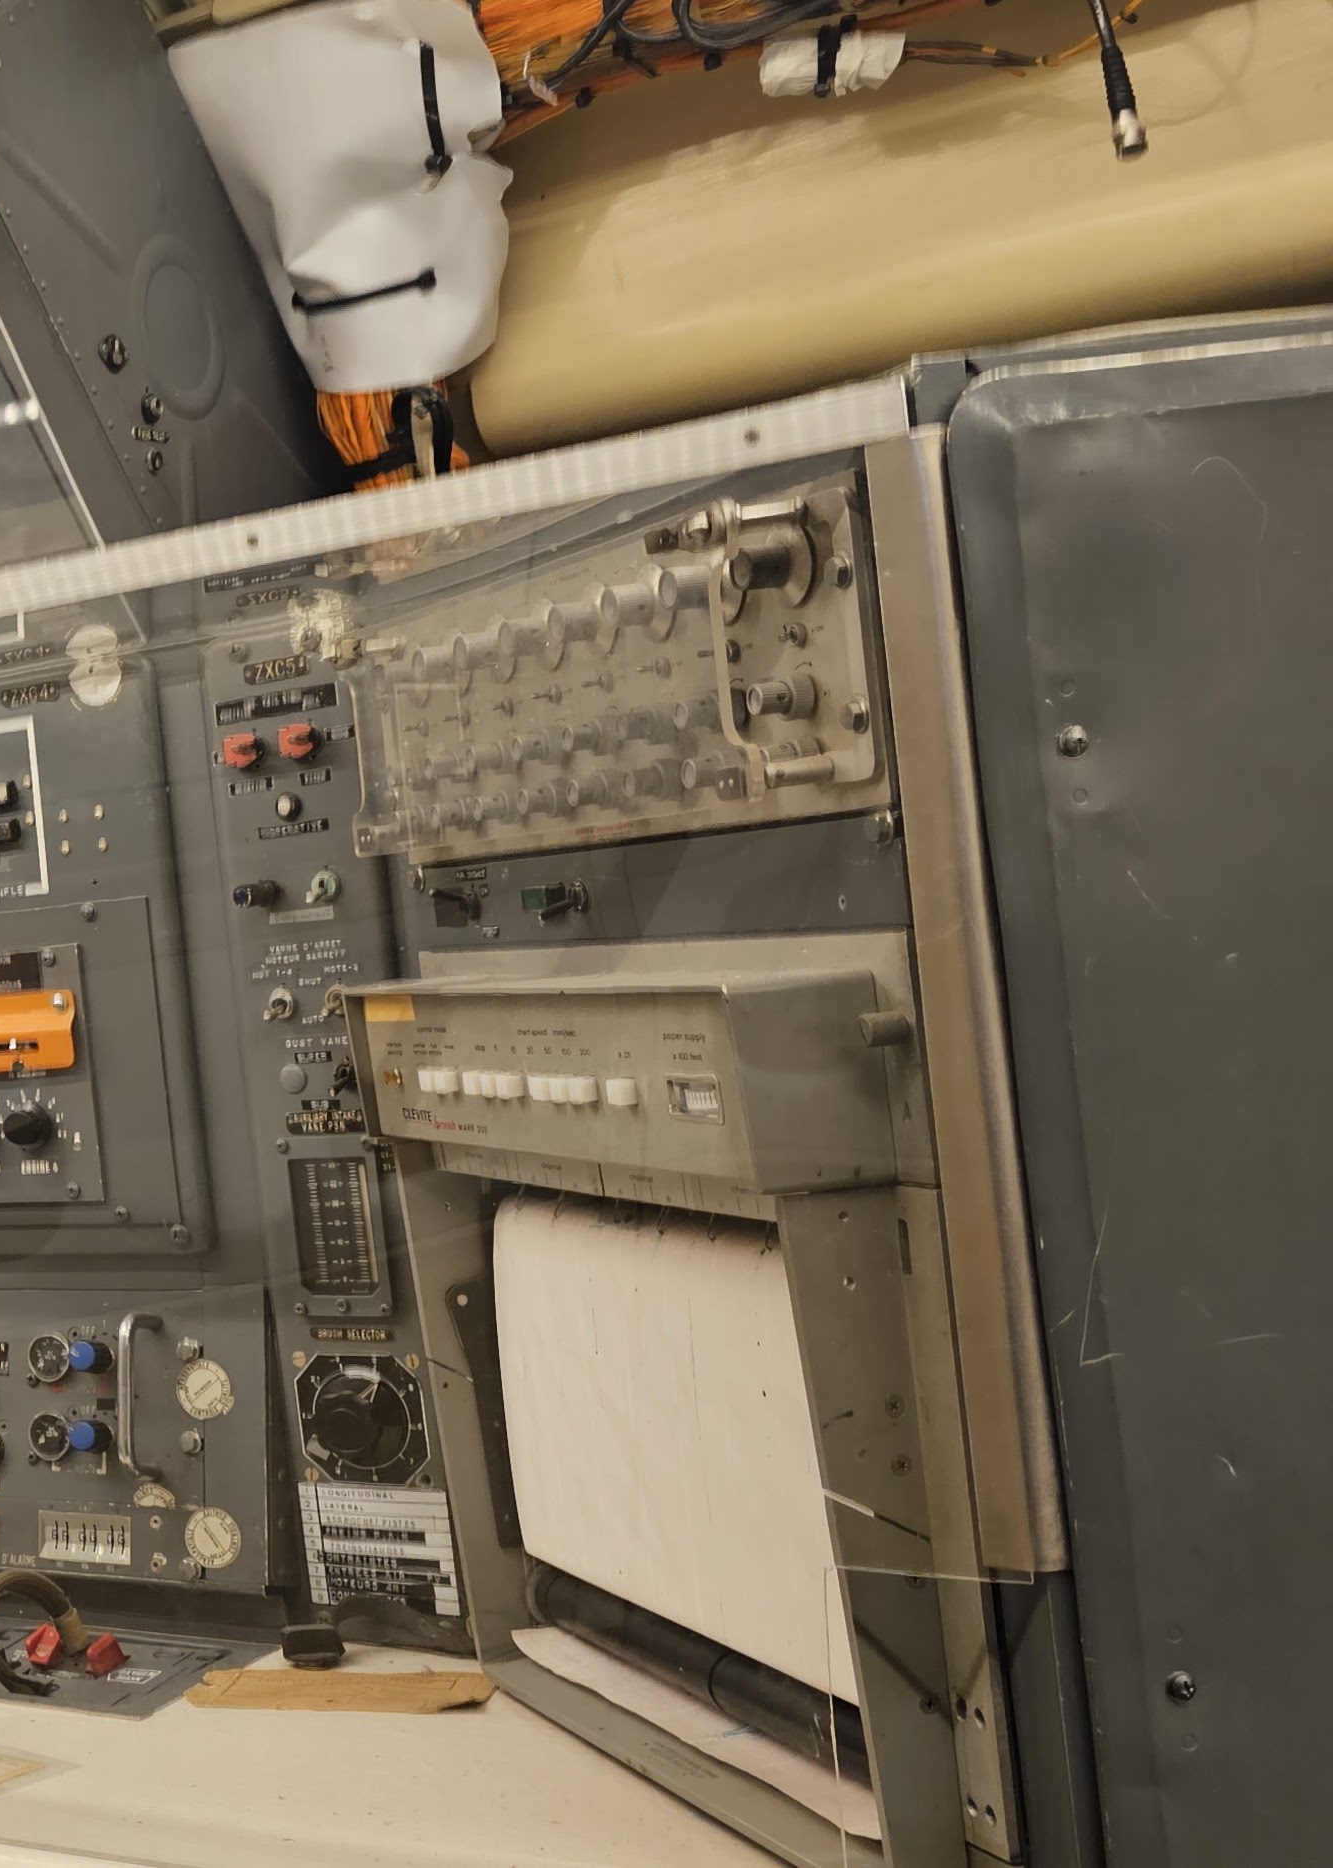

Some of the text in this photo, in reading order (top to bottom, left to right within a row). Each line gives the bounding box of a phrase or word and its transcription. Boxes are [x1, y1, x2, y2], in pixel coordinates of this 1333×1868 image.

[254, 657, 296, 681] ZXC5
[11, 684, 49, 707] ZXC4
[269, 940, 341, 955] VANNE D'ARRET
[265, 953, 300, 965] MOTEUR
[298, 977, 322, 986] SHUT
[302, 1015, 324, 1025] AUTO
[285, 1035, 349, 1048] GUST VANE
[662, 1032, 705, 1043] paper supply
[544, 1047, 551, 1055] 50
[561, 1048, 571, 1056] 100
[579, 1048, 590, 1056] 200
[402, 1107, 432, 1123] CLEVITE
[301, 1120, 345, 1133] VANE PSN
[317, 1327, 386, 1340] BRUSH SELECTOR
[321, 1489, 394, 1500] LONGITUDINAL
[324, 1502, 364, 1512] LATERAL
[1, 1553, 37, 1567] D'ALARME
